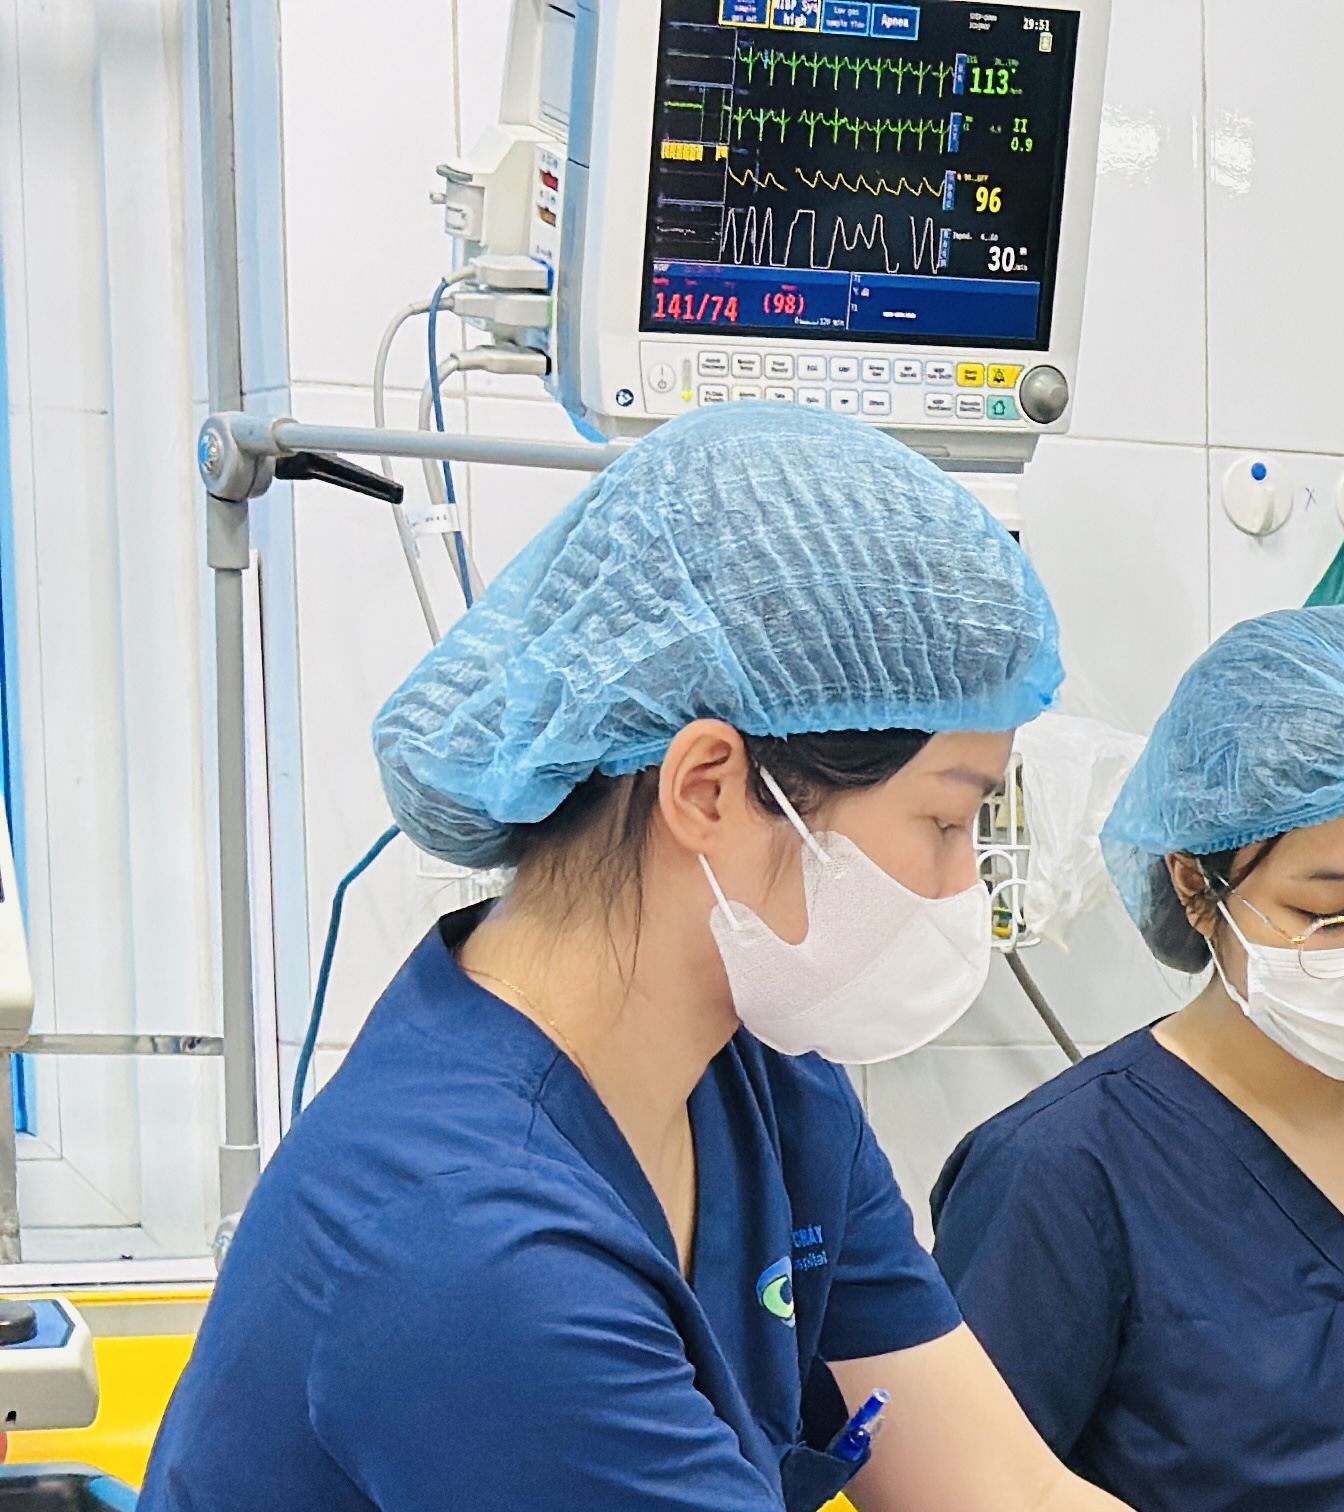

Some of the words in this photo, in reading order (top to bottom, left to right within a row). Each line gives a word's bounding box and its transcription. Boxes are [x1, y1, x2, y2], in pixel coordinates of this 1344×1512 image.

[880, 13, 909, 28] Apnea
[969, 67, 1010, 95] 113
[1010, 136, 1034, 153] 0.9
[975, 186, 1002, 213] 96
[987, 245, 1016, 273] 30
[652, 292, 739, 322] 141/74
[763, 293, 806, 317] (98)
